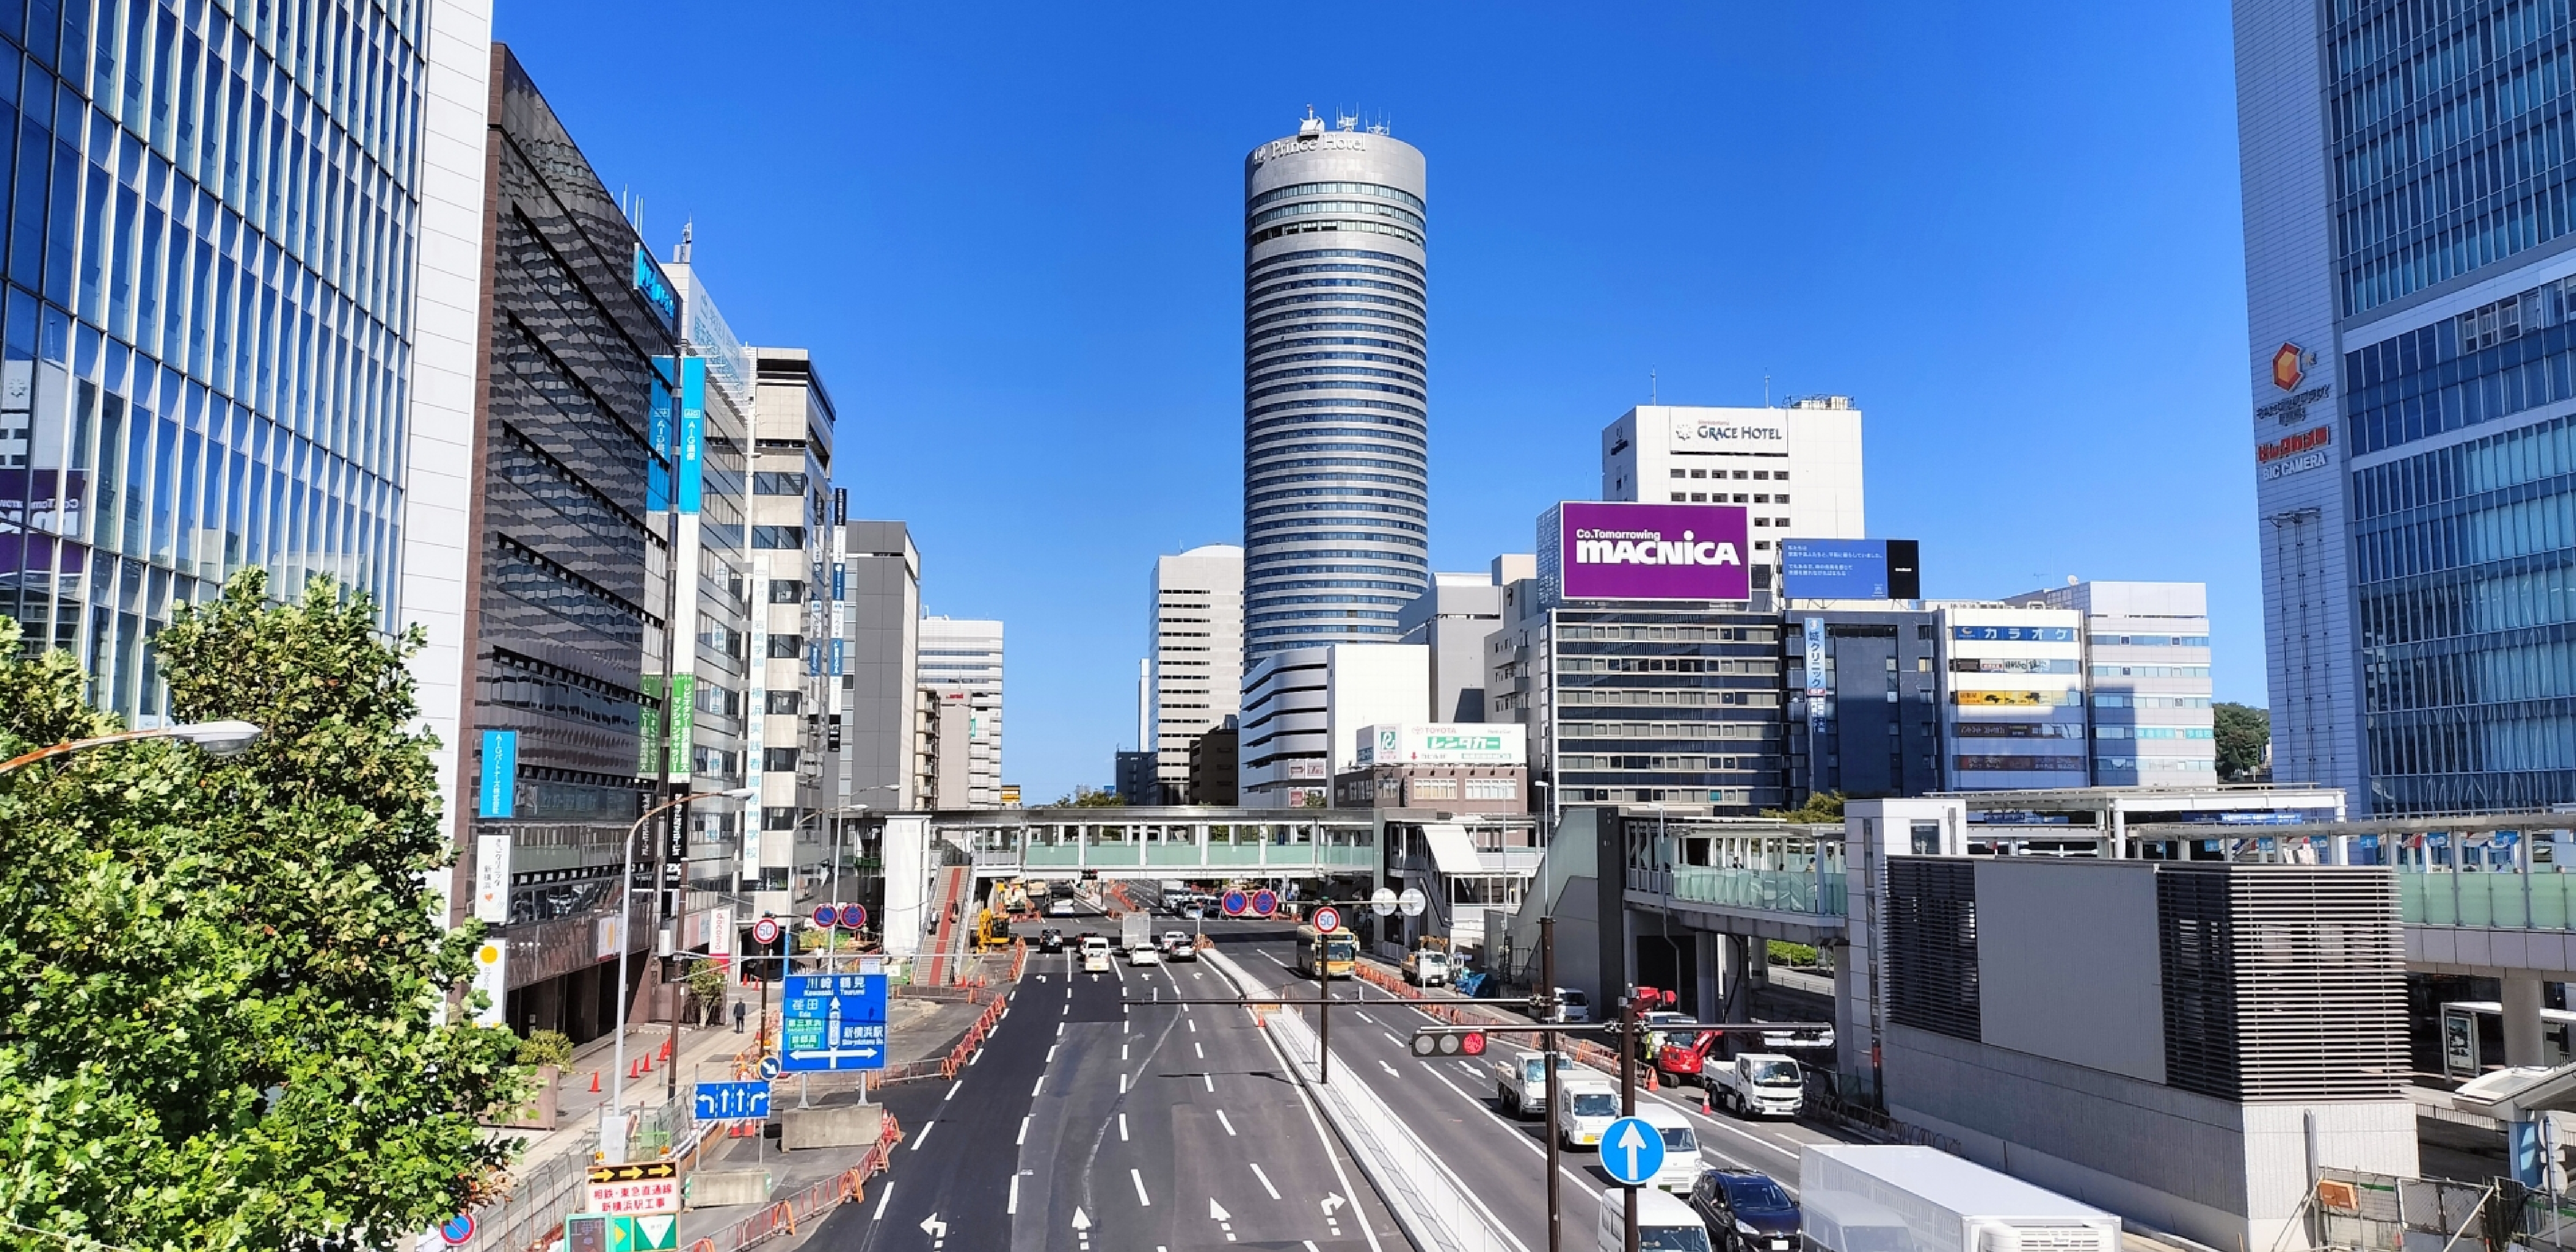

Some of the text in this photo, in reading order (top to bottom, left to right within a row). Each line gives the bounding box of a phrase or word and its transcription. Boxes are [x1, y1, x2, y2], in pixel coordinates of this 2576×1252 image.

[1271, 133, 1366, 160] Prince Hotel
[1697, 425, 1782, 440] GRACE HOTEL
[2281, 452, 2327, 475] CAMERA
[1576, 529, 1661, 541] Co.Tomorrowing
[1984, 627, 2068, 640] カラオケ
[1429, 737, 1500, 750] レンタカー
[1320, 914, 1334, 926] 50
[715, 913, 725, 950] docomo
[759, 924, 773, 936] 50
[844, 1026, 883, 1038] 新横浜駅
[602, 1197, 665, 1212] 新横浜駅工事
[571, 1219, 604, 1236] 工事中
